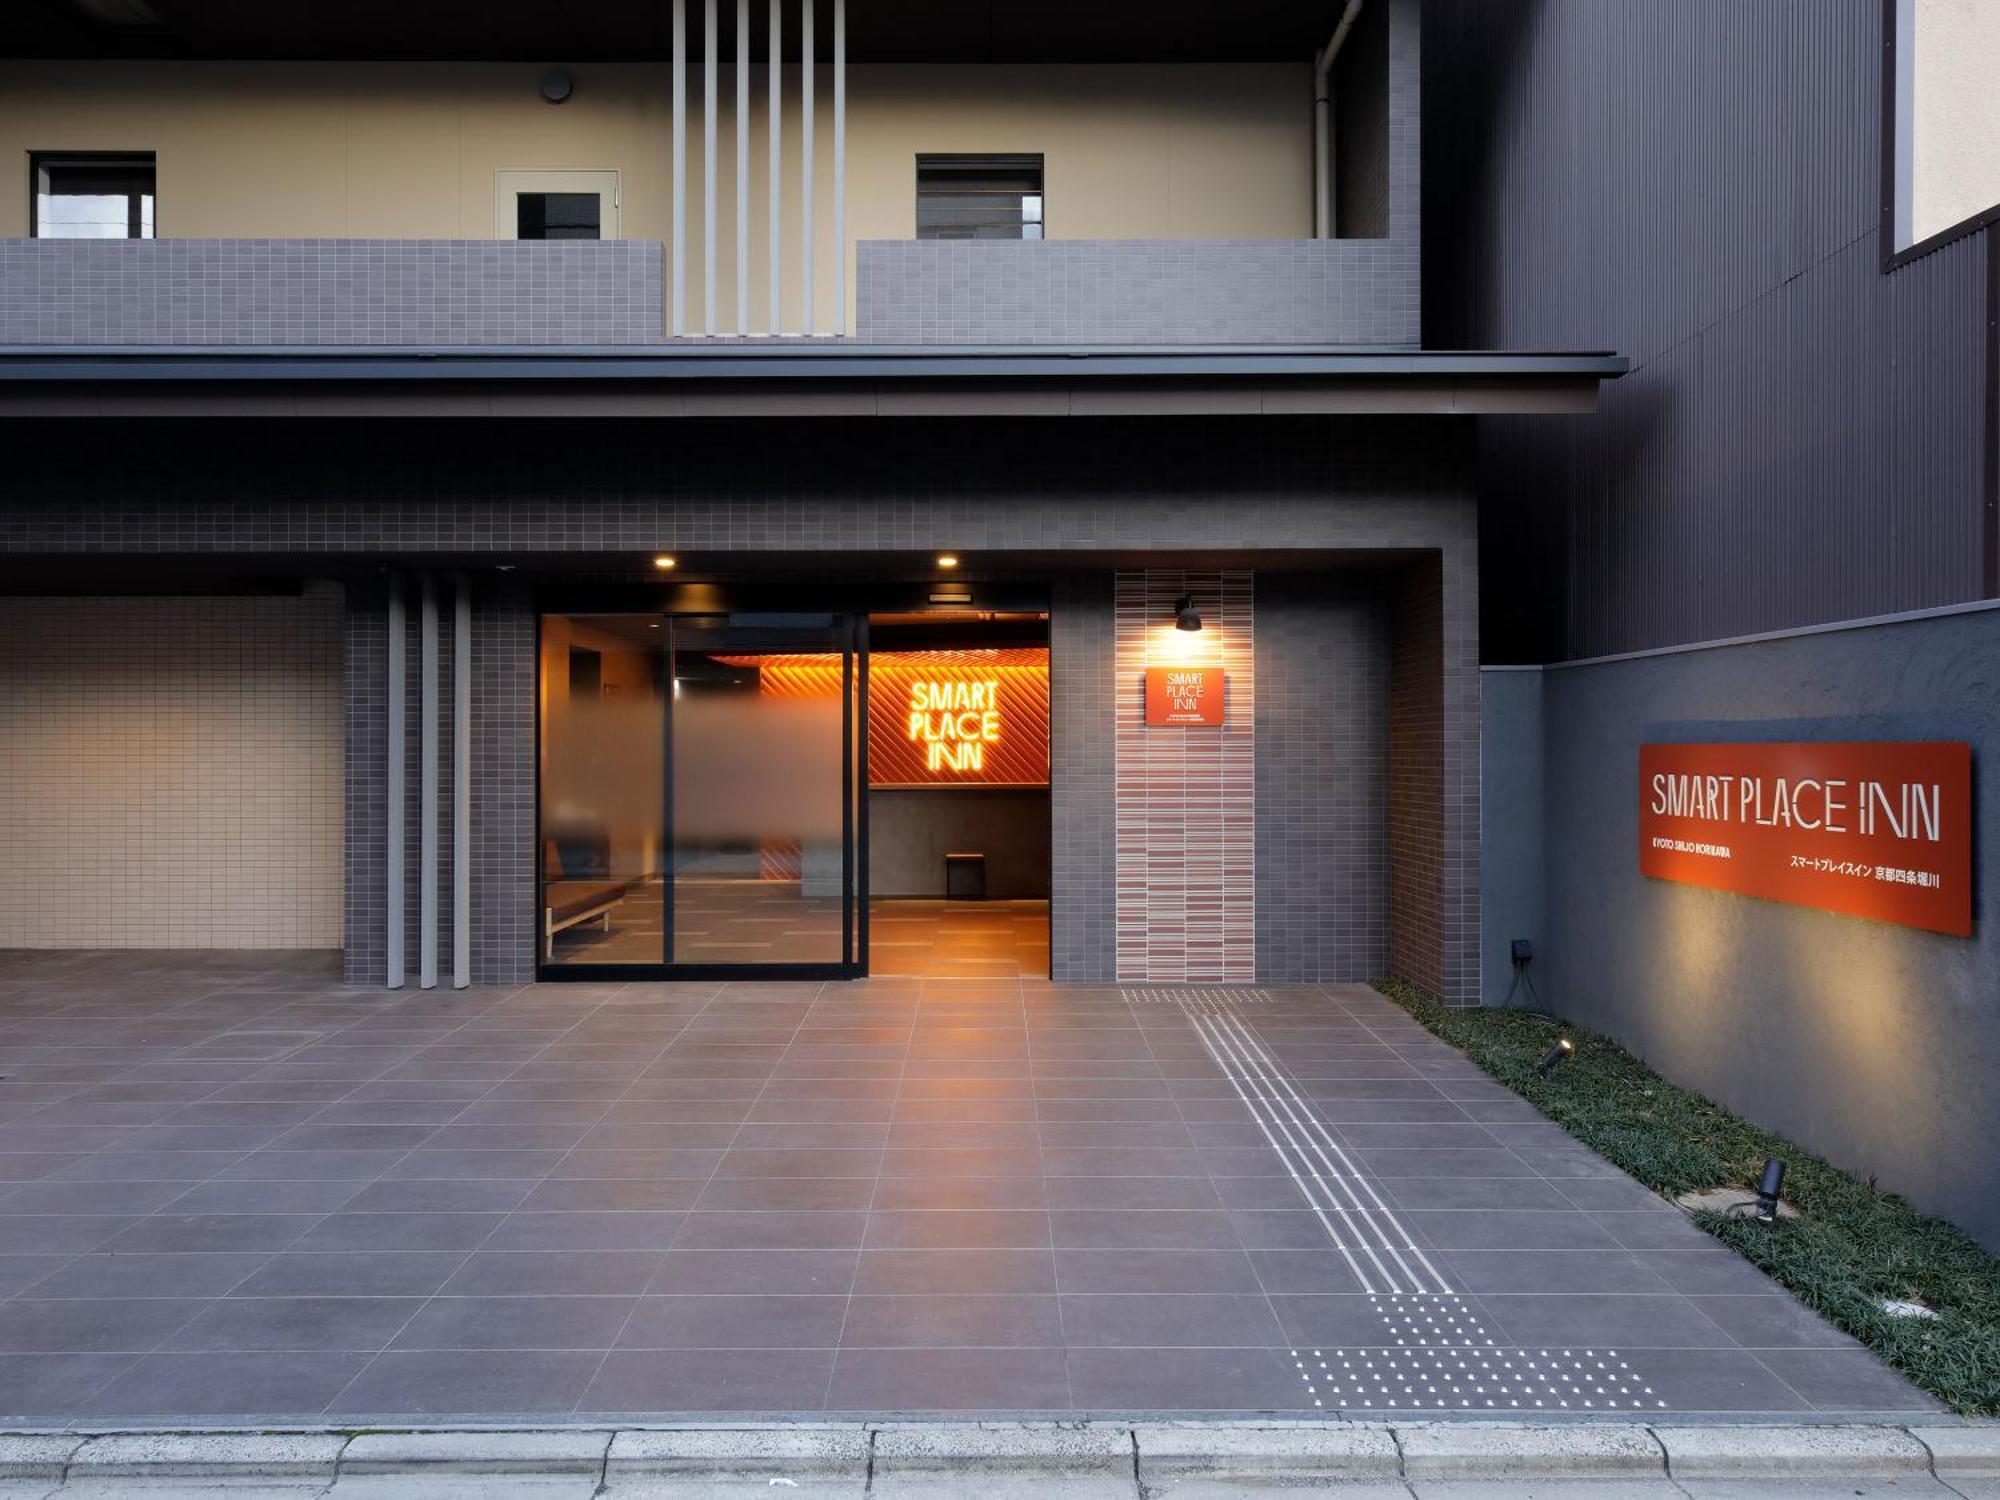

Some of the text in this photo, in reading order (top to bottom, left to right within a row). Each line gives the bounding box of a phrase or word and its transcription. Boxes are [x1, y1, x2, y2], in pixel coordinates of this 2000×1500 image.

[1167, 672, 1204, 685] SMART
[911, 682, 999, 710] SMART
[1166, 685, 1204, 698] PLACE
[1174, 698, 1197, 710] INN
[909, 711, 1000, 741] PLACE
[928, 741, 983, 772] INN
[1652, 774, 1940, 841] SMART PLACE INN
[1652, 837, 1674, 849] KYOTO
